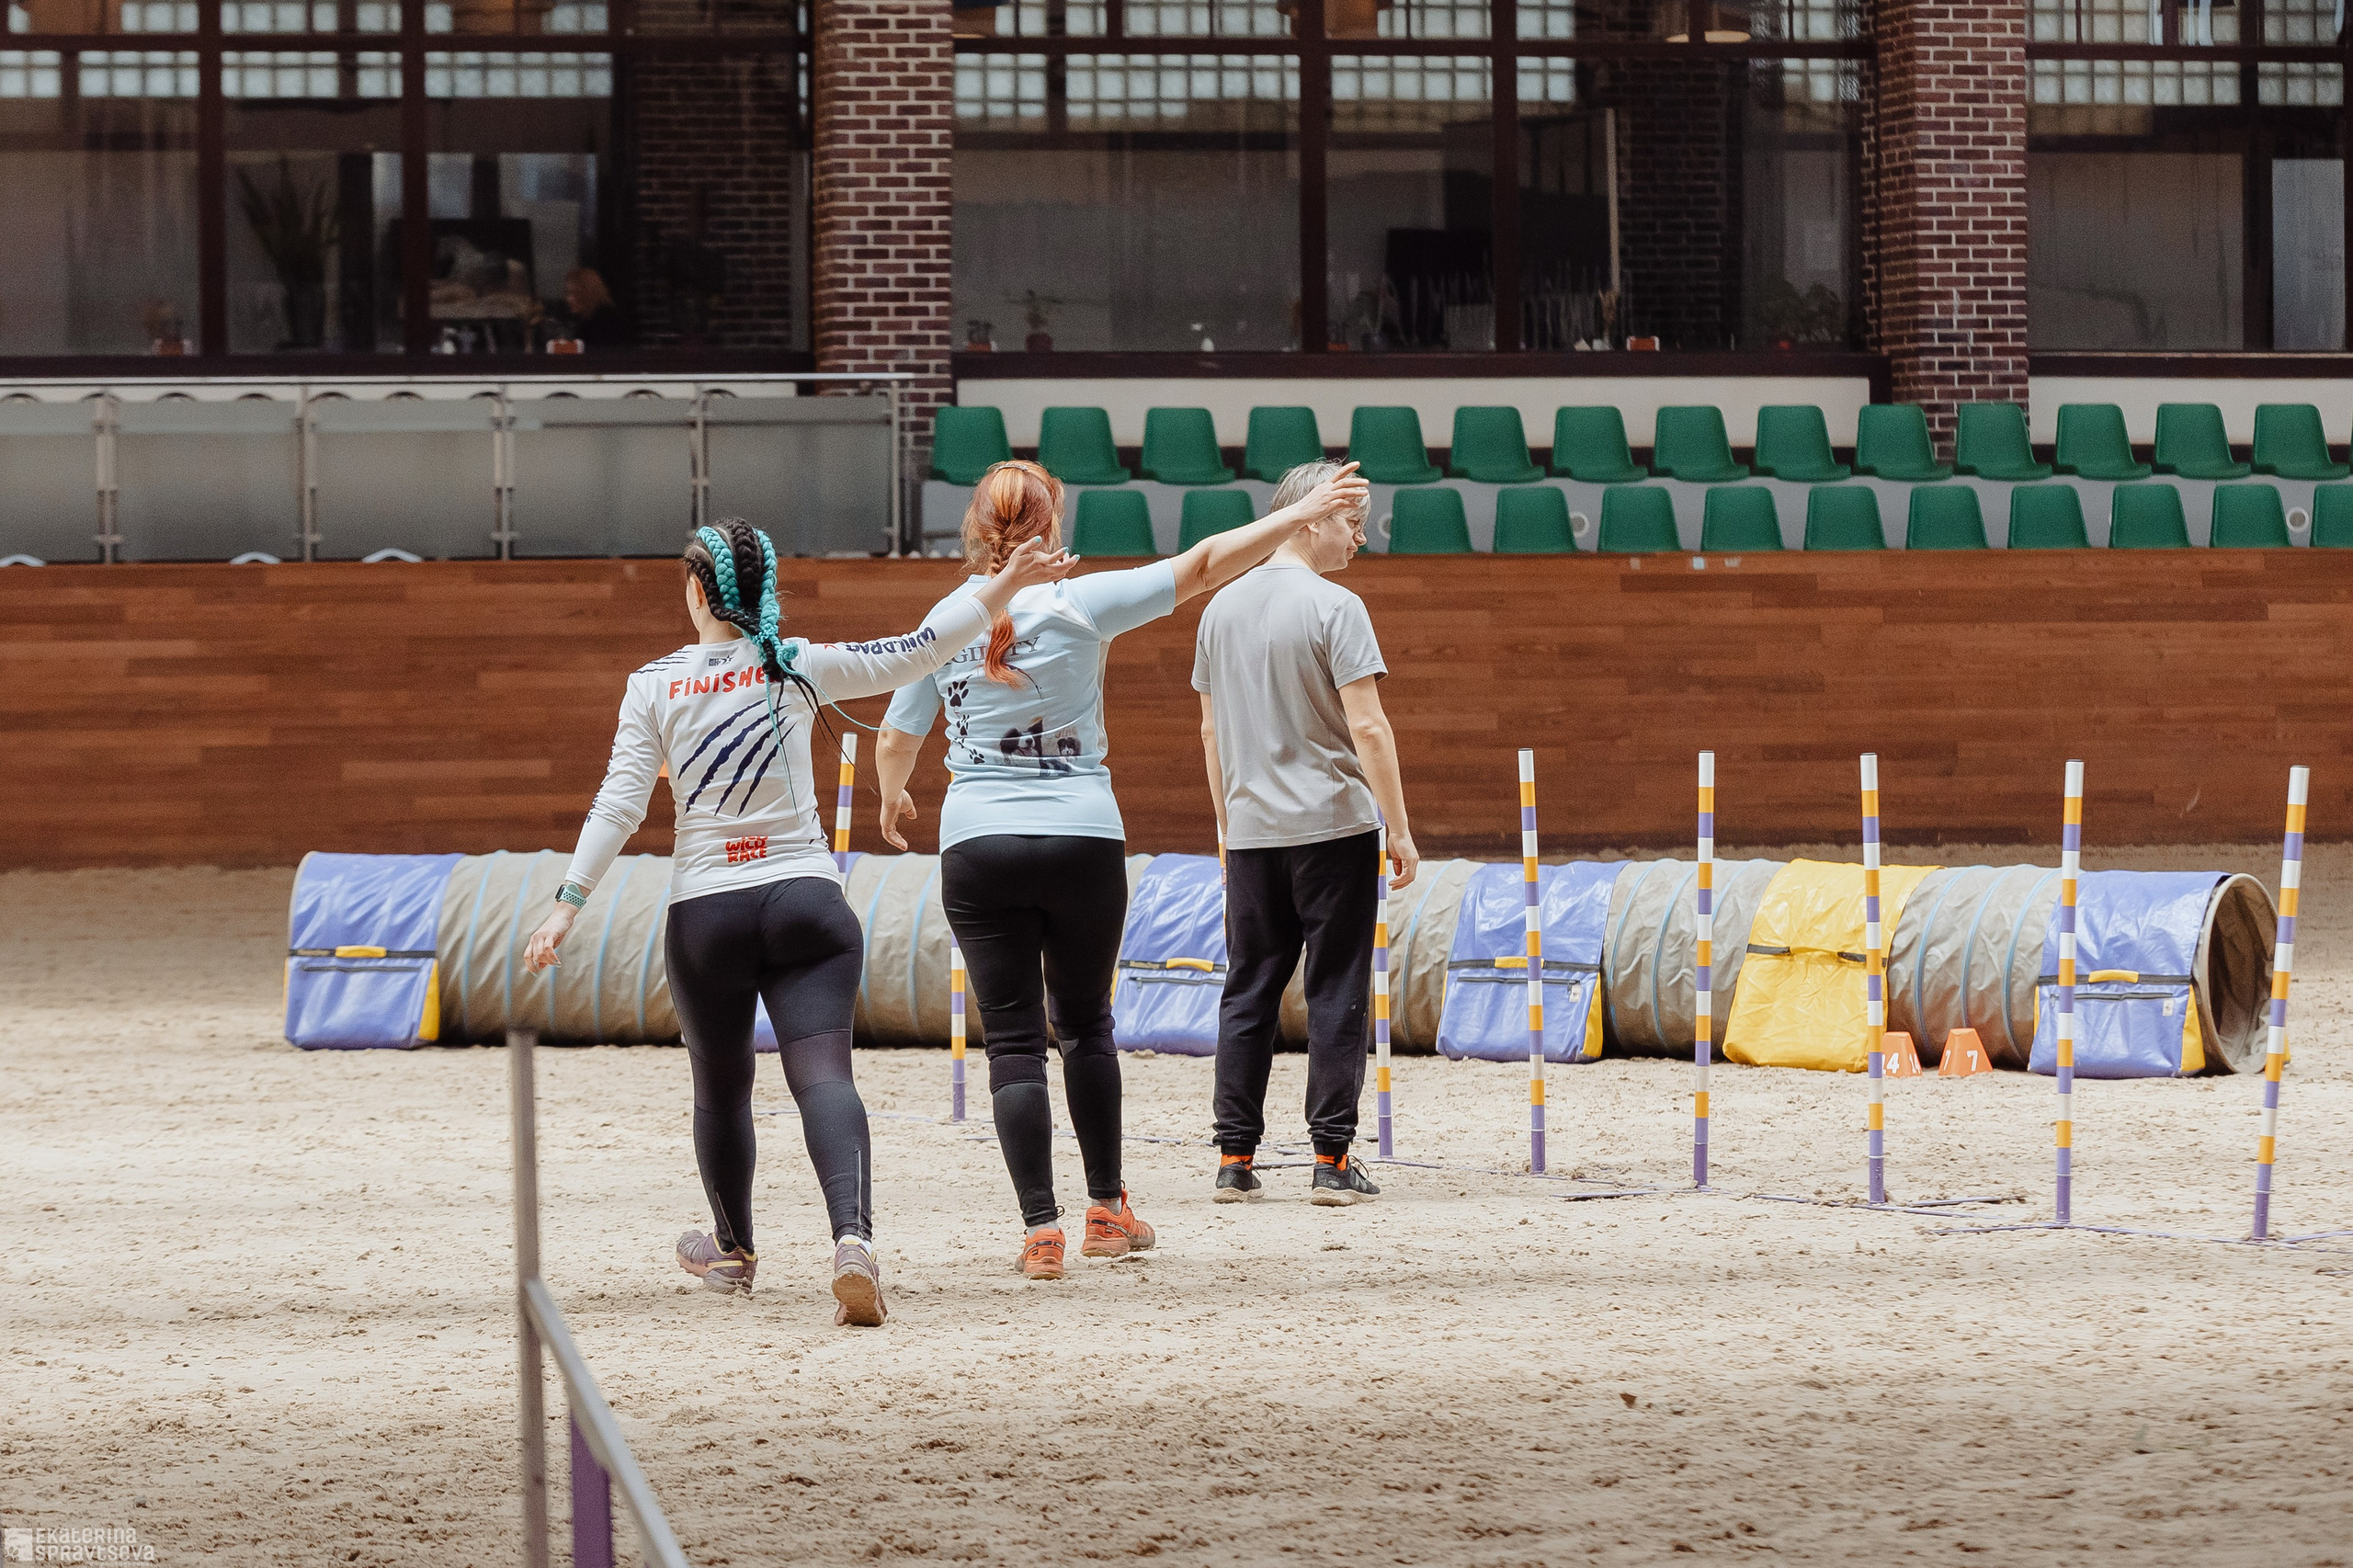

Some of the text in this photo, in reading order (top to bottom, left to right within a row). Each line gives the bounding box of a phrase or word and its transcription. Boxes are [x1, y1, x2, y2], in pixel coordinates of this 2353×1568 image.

[669, 665, 778, 700] FiNiSHE
[727, 846, 767, 863] RACE
[1966, 1050, 1978, 1072] 7
